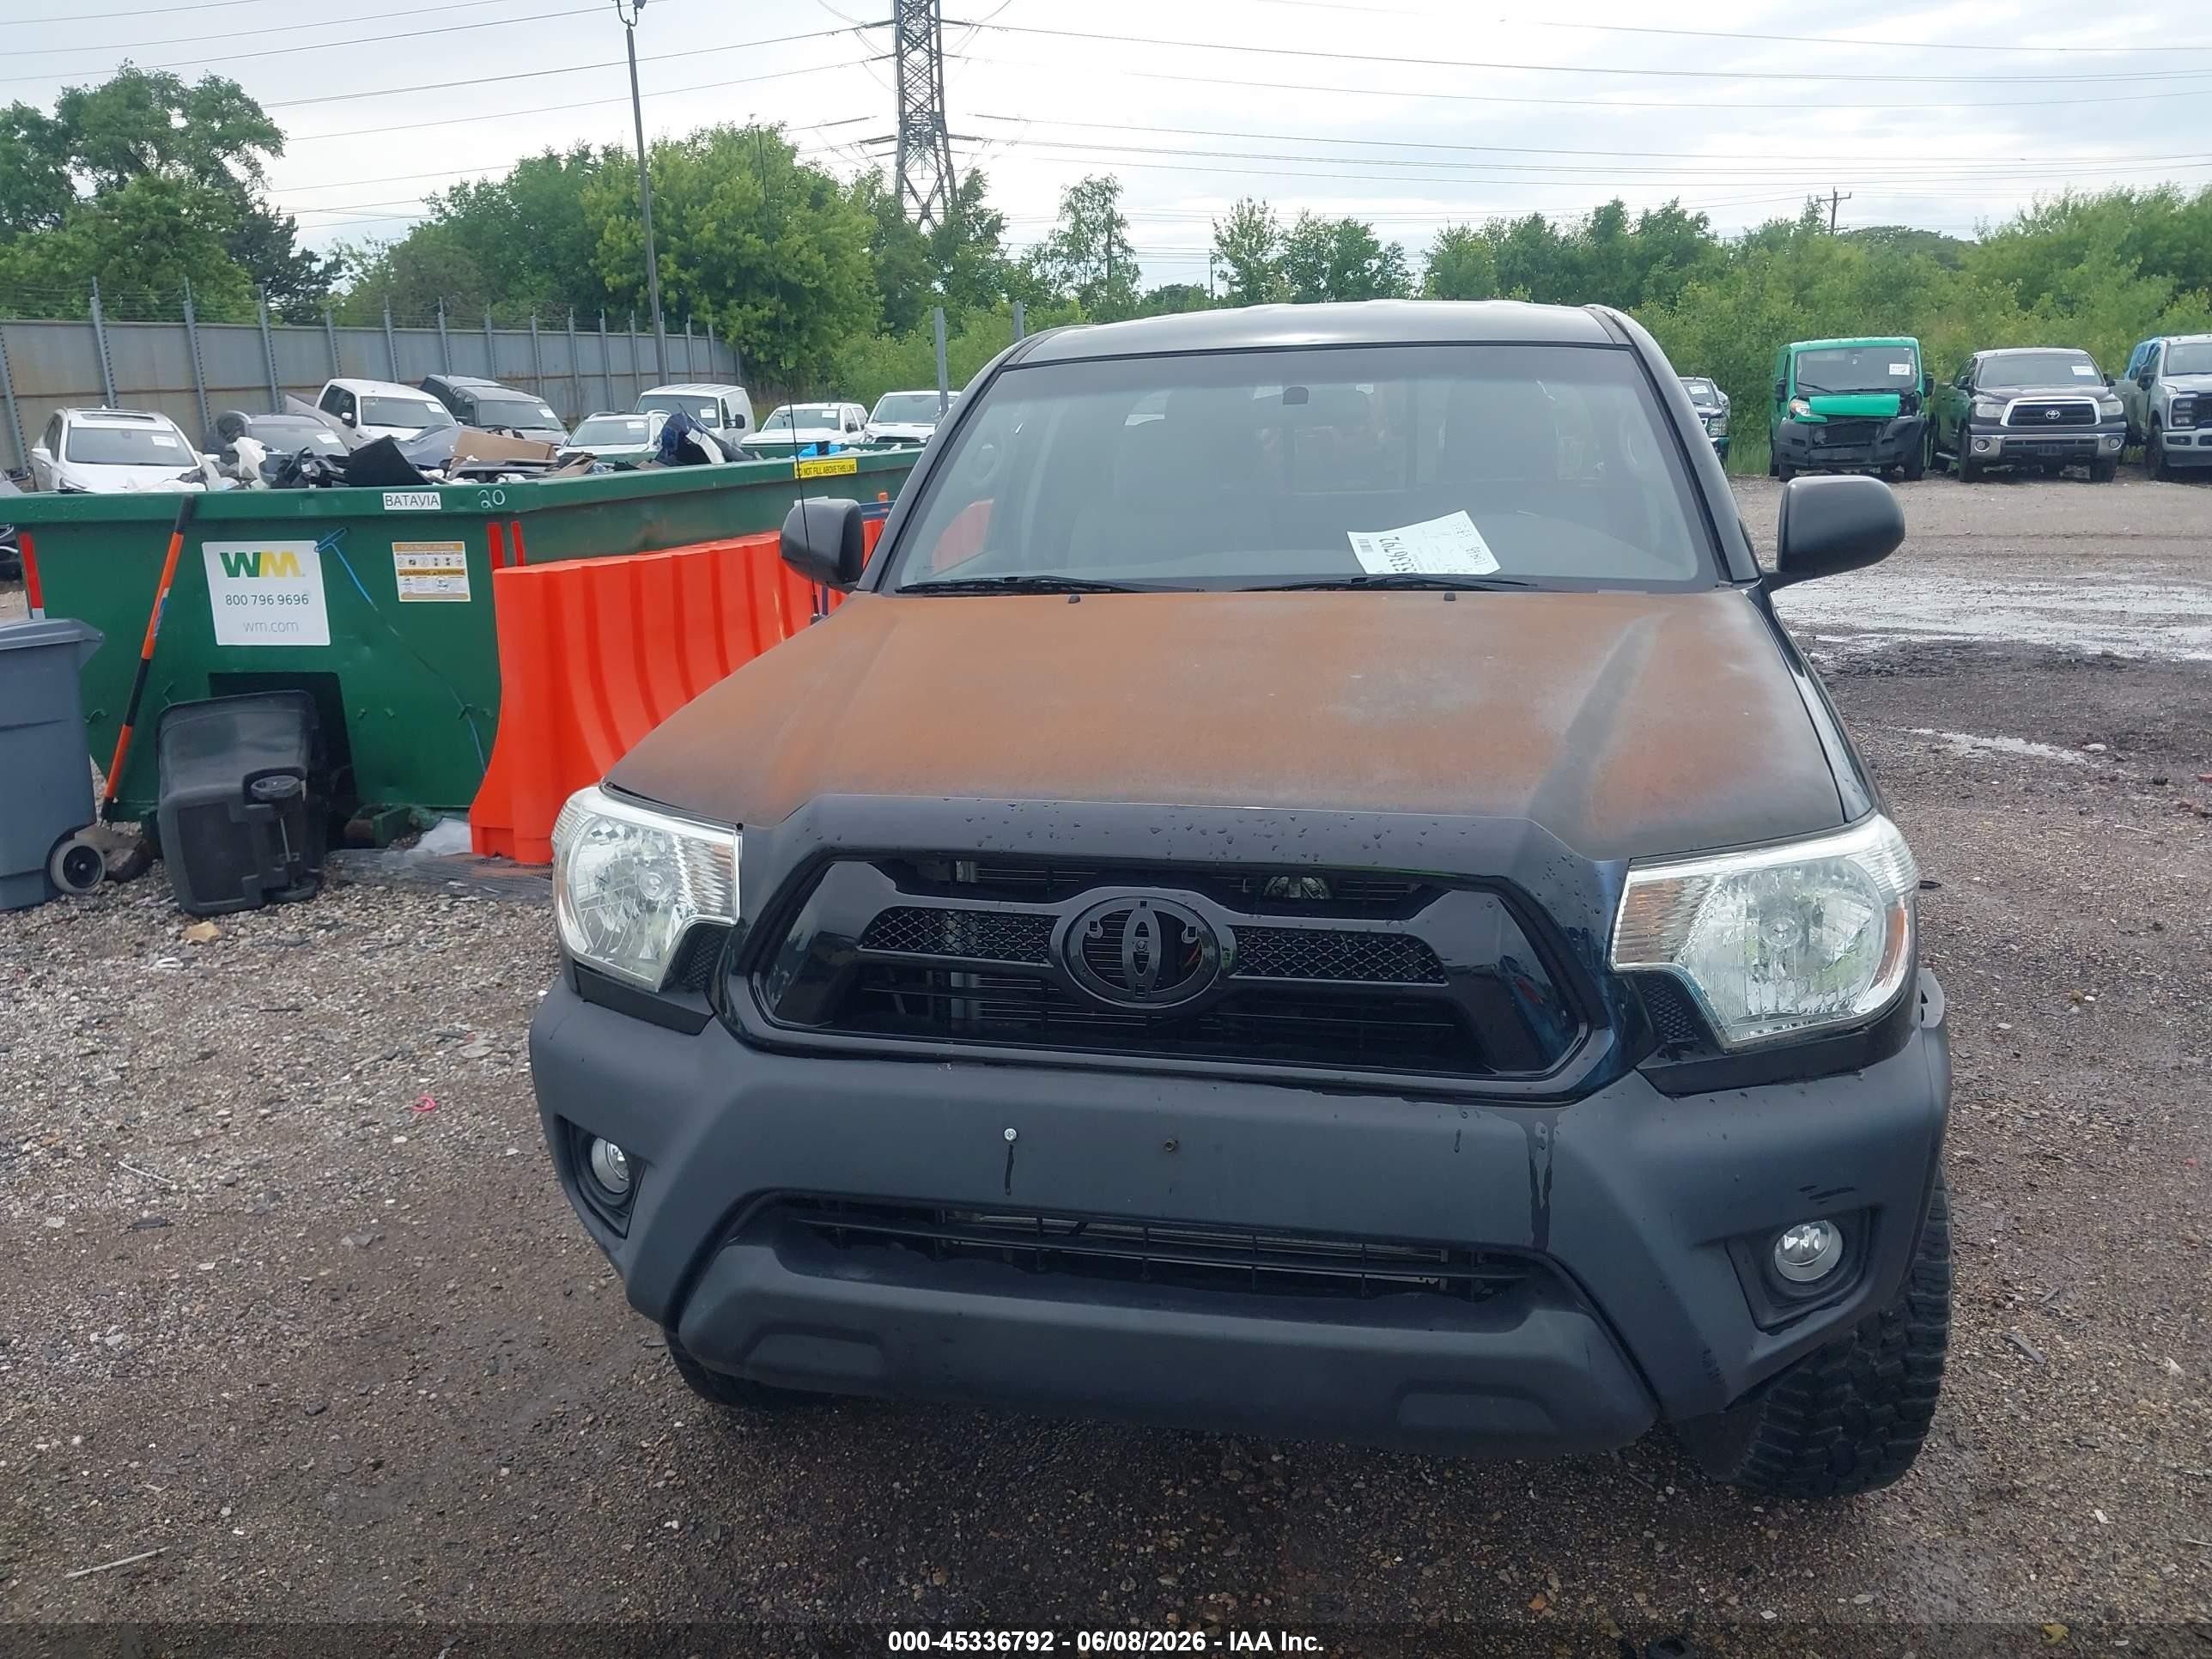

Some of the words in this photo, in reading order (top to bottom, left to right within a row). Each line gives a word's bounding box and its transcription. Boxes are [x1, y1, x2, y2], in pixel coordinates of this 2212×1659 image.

[804, 467, 812, 476] NOT
[813, 466, 823, 475] FILL
[823, 465, 837, 474] ABOVE
[837, 465, 846, 473] THIS
[847, 464, 855, 472] LINE
[385, 495, 439, 506] BATAVIA
[477, 489, 506, 508] 20
[220, 552, 302, 577] WM
[226, 595, 248, 605] 800
[252, 595, 274, 605] 796
[277, 594, 309, 605] 9696
[244, 621, 299, 633] wm.com
